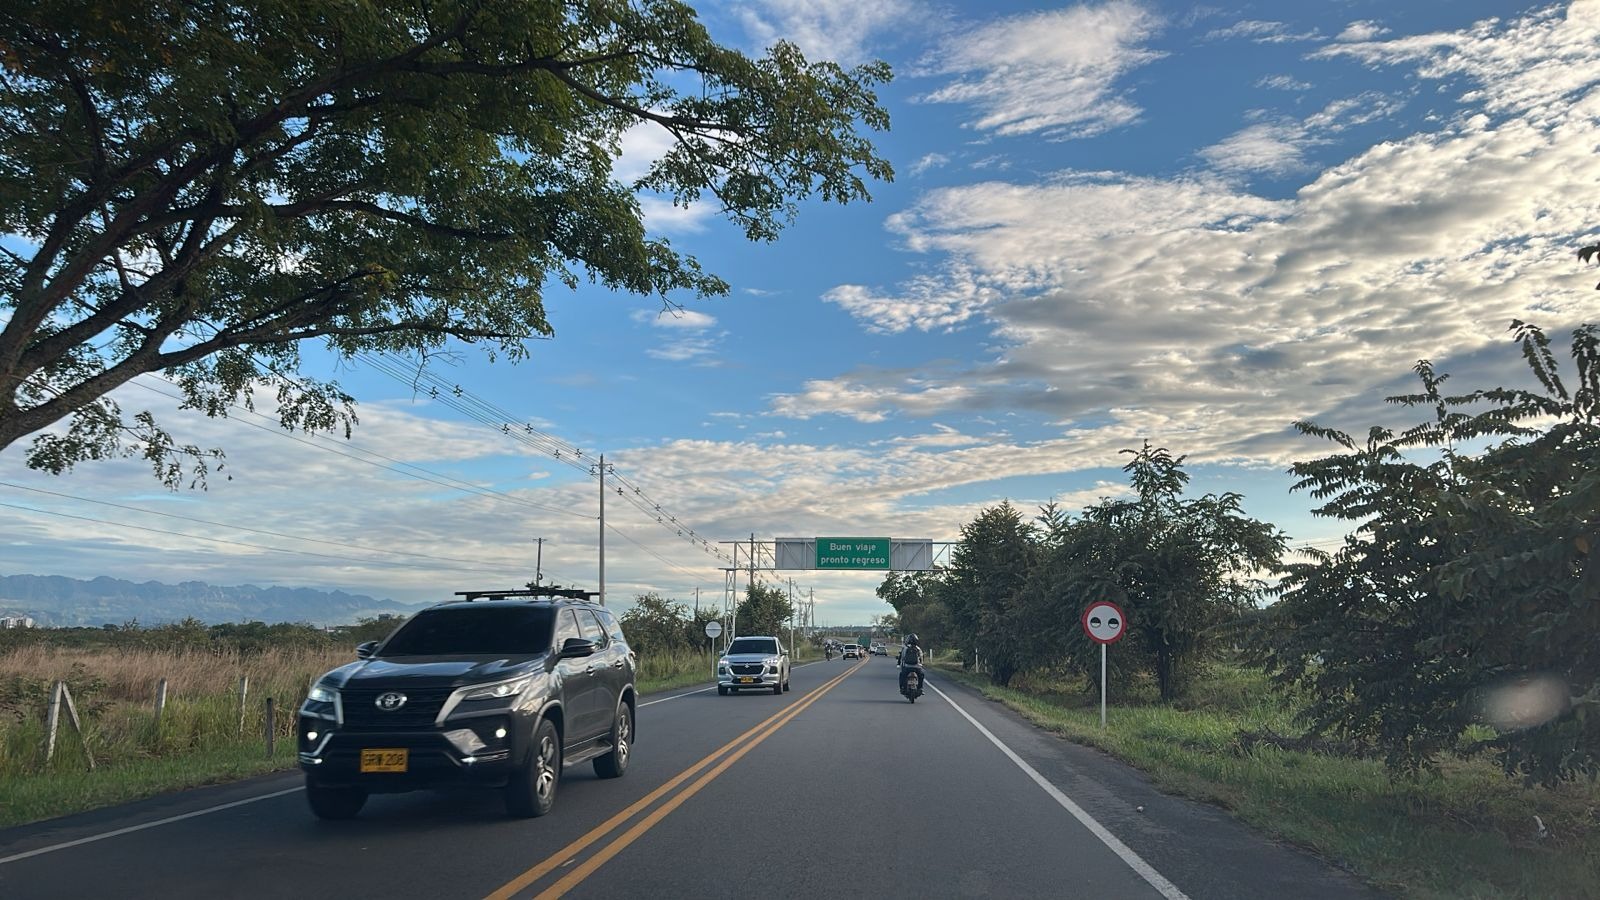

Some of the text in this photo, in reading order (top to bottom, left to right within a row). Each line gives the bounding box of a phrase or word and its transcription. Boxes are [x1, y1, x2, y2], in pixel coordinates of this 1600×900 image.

[830, 542, 876, 554] Buen viaje
[820, 556, 886, 566] pronto regreso
